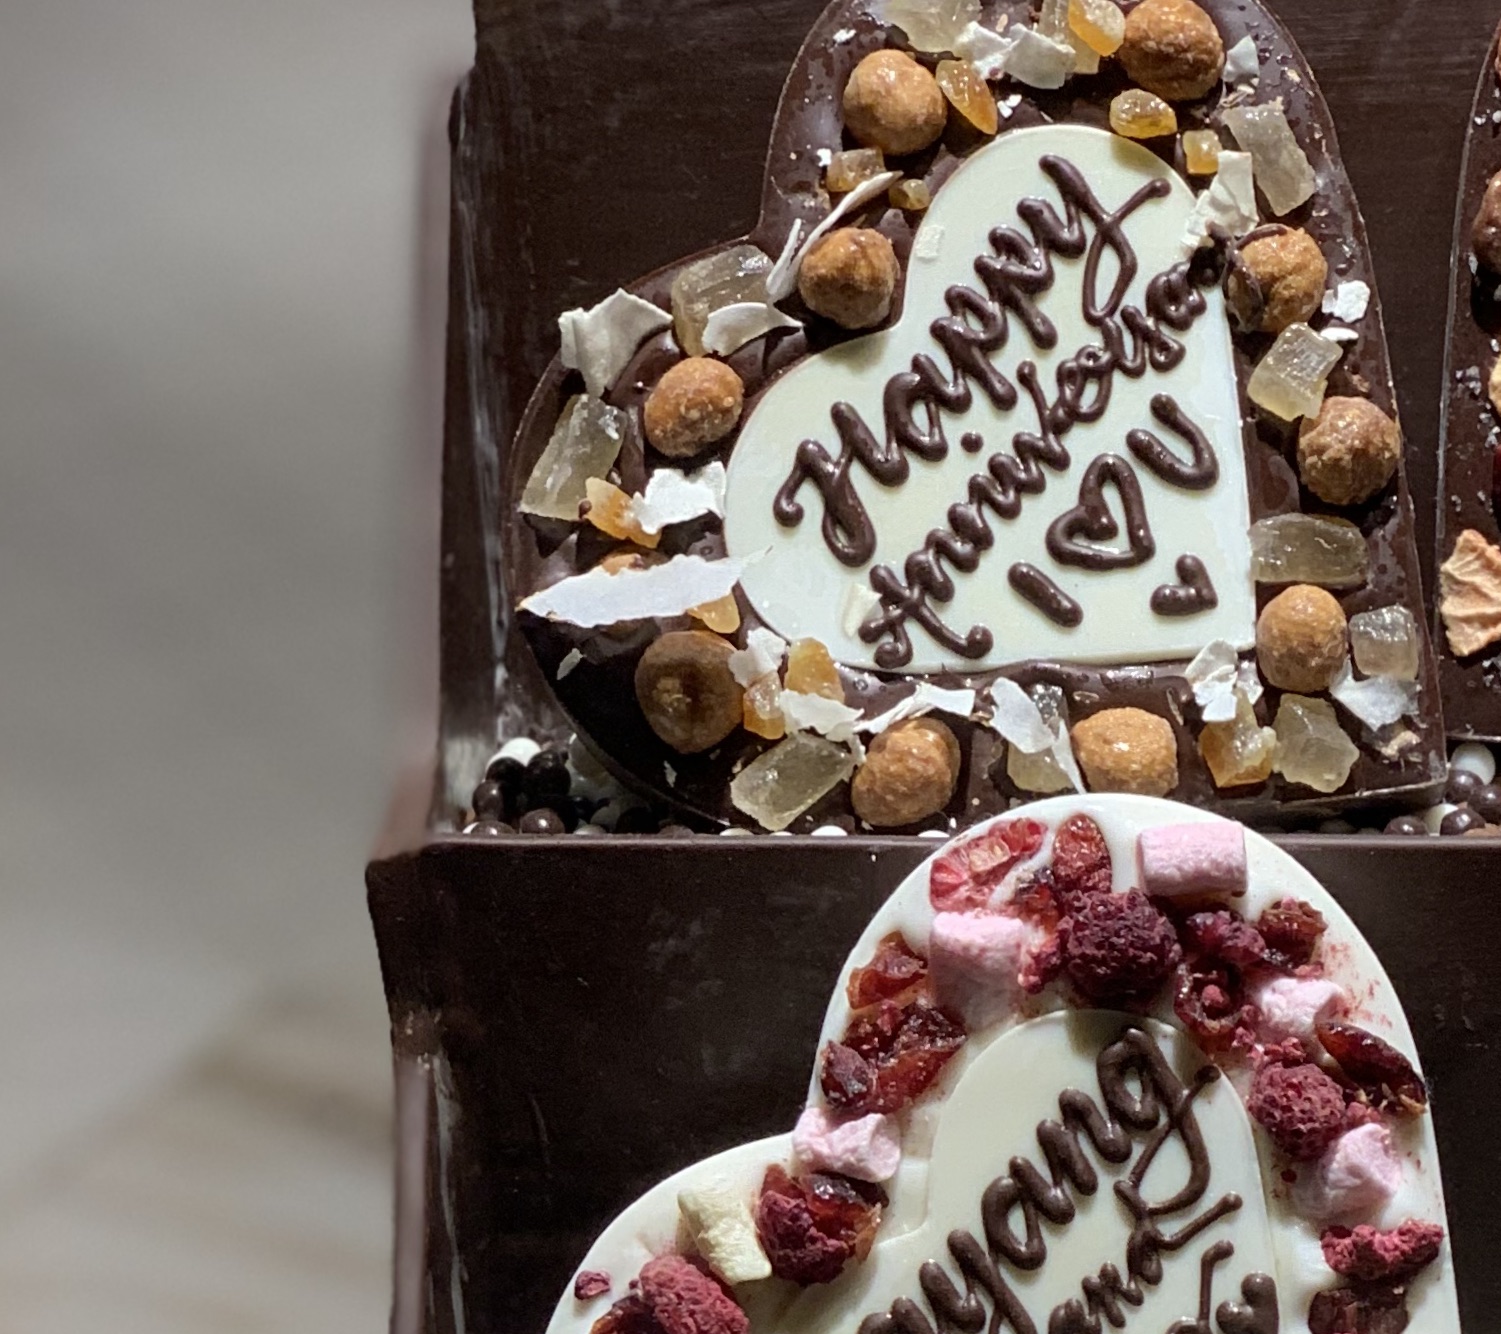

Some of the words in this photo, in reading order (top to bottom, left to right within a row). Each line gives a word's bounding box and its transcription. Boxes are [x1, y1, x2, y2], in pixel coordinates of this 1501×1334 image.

[773, 154, 1171, 567] Happy
[1008, 561, 1083, 627] I
[1126, 392, 1219, 489] U
